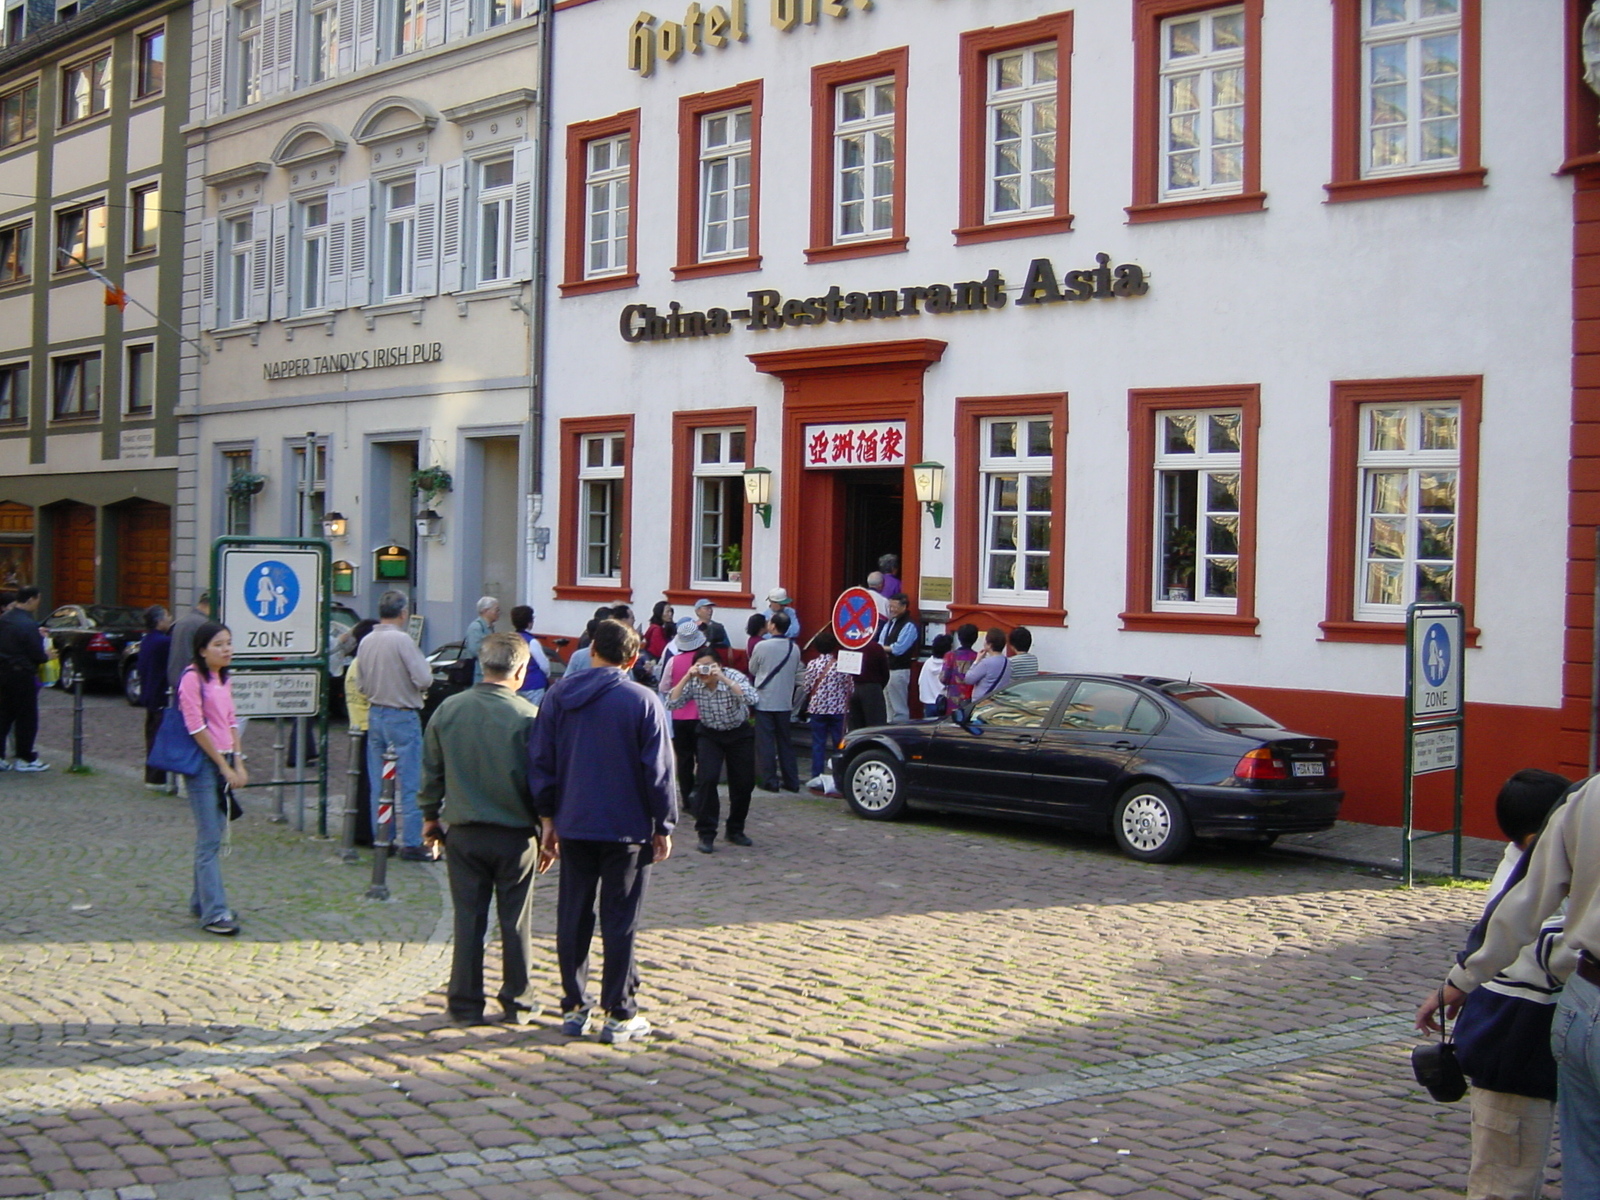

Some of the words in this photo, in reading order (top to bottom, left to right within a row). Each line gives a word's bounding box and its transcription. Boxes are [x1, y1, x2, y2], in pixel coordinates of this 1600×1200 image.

[620, 269, 1007, 342] China-Restaurant
[1015, 252, 1149, 305] Asia
[263, 358, 310, 380] NAPPER
[314, 350, 369, 373] TANDY'S
[373, 346, 408, 367] IRISH
[413, 342, 442, 362] PUB
[934, 537, 941, 550] 2
[1425, 690, 1448, 708] ZONE
